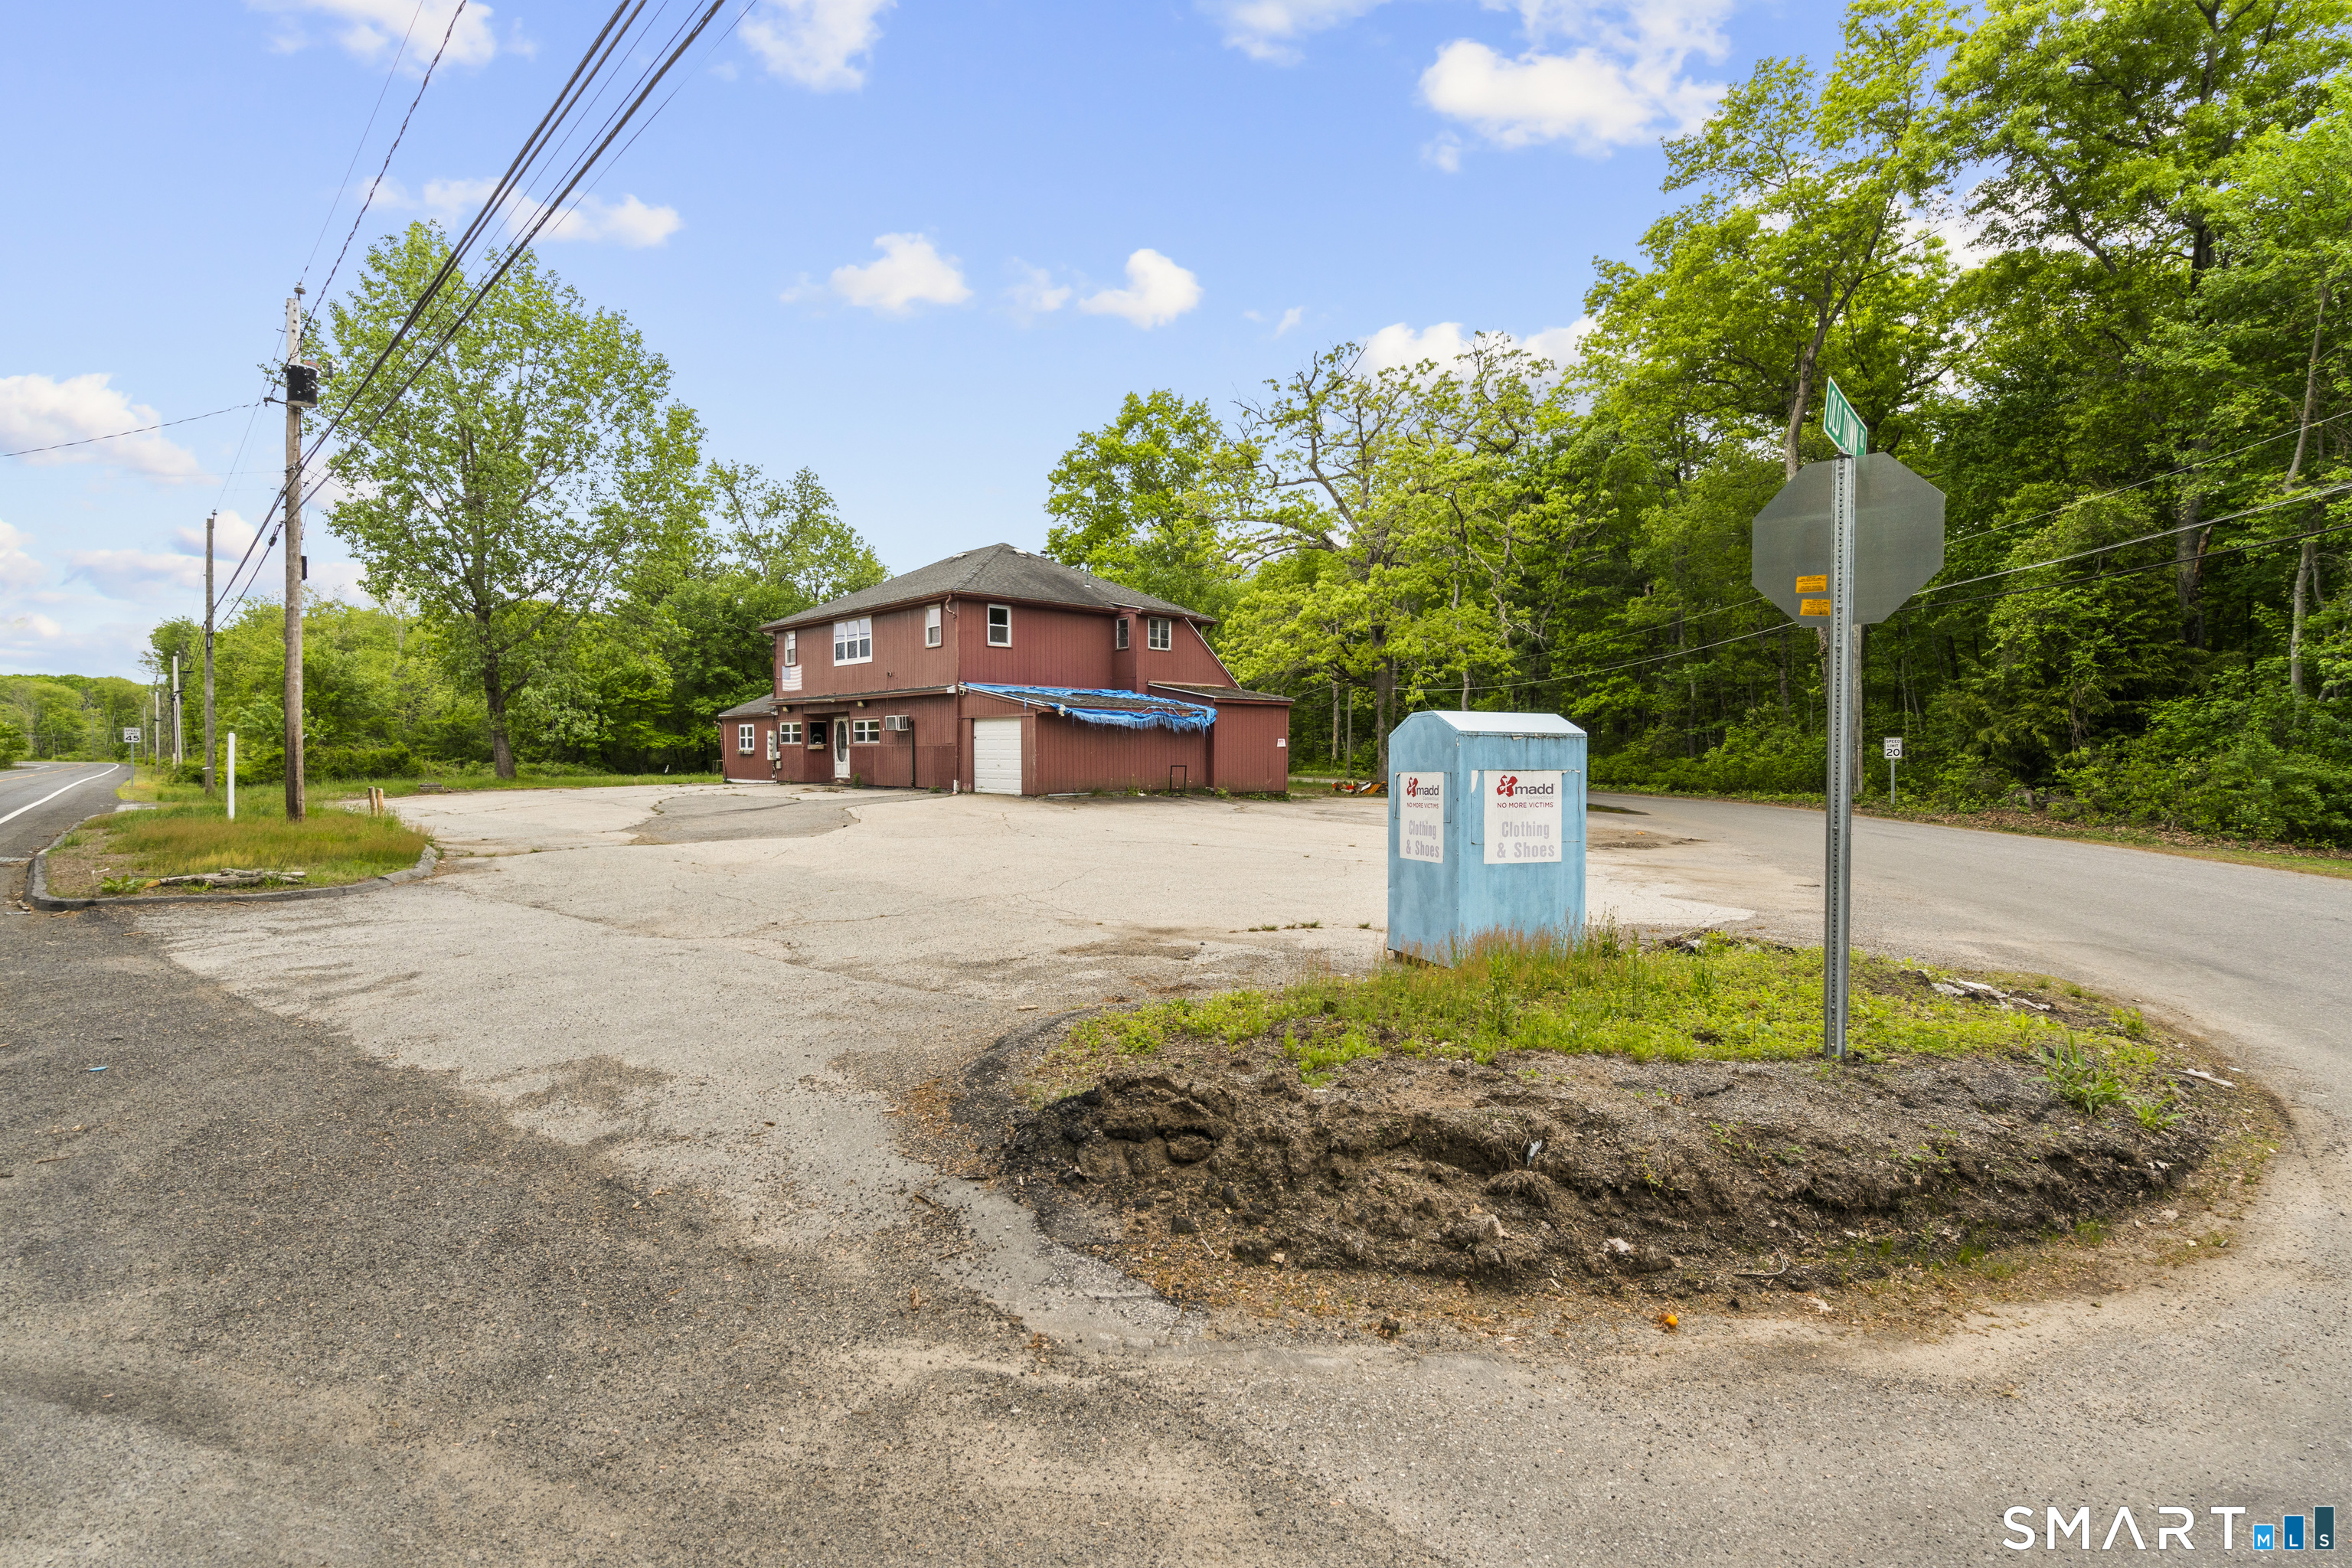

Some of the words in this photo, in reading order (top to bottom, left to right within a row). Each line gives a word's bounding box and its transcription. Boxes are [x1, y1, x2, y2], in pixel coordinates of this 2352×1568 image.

[1828, 390, 1842, 437] OLD
[1842, 407, 1859, 457] TOWN
[1416, 785, 1439, 795] madd
[1515, 783, 1554, 795] madd
[1409, 819, 1436, 840] Clothing
[1501, 821, 1550, 840] Clothing
[1406, 839, 1412, 854] &
[1415, 840, 1439, 858] Shoes
[1497, 842, 1507, 858] &
[1514, 841, 1555, 858] Shoes
